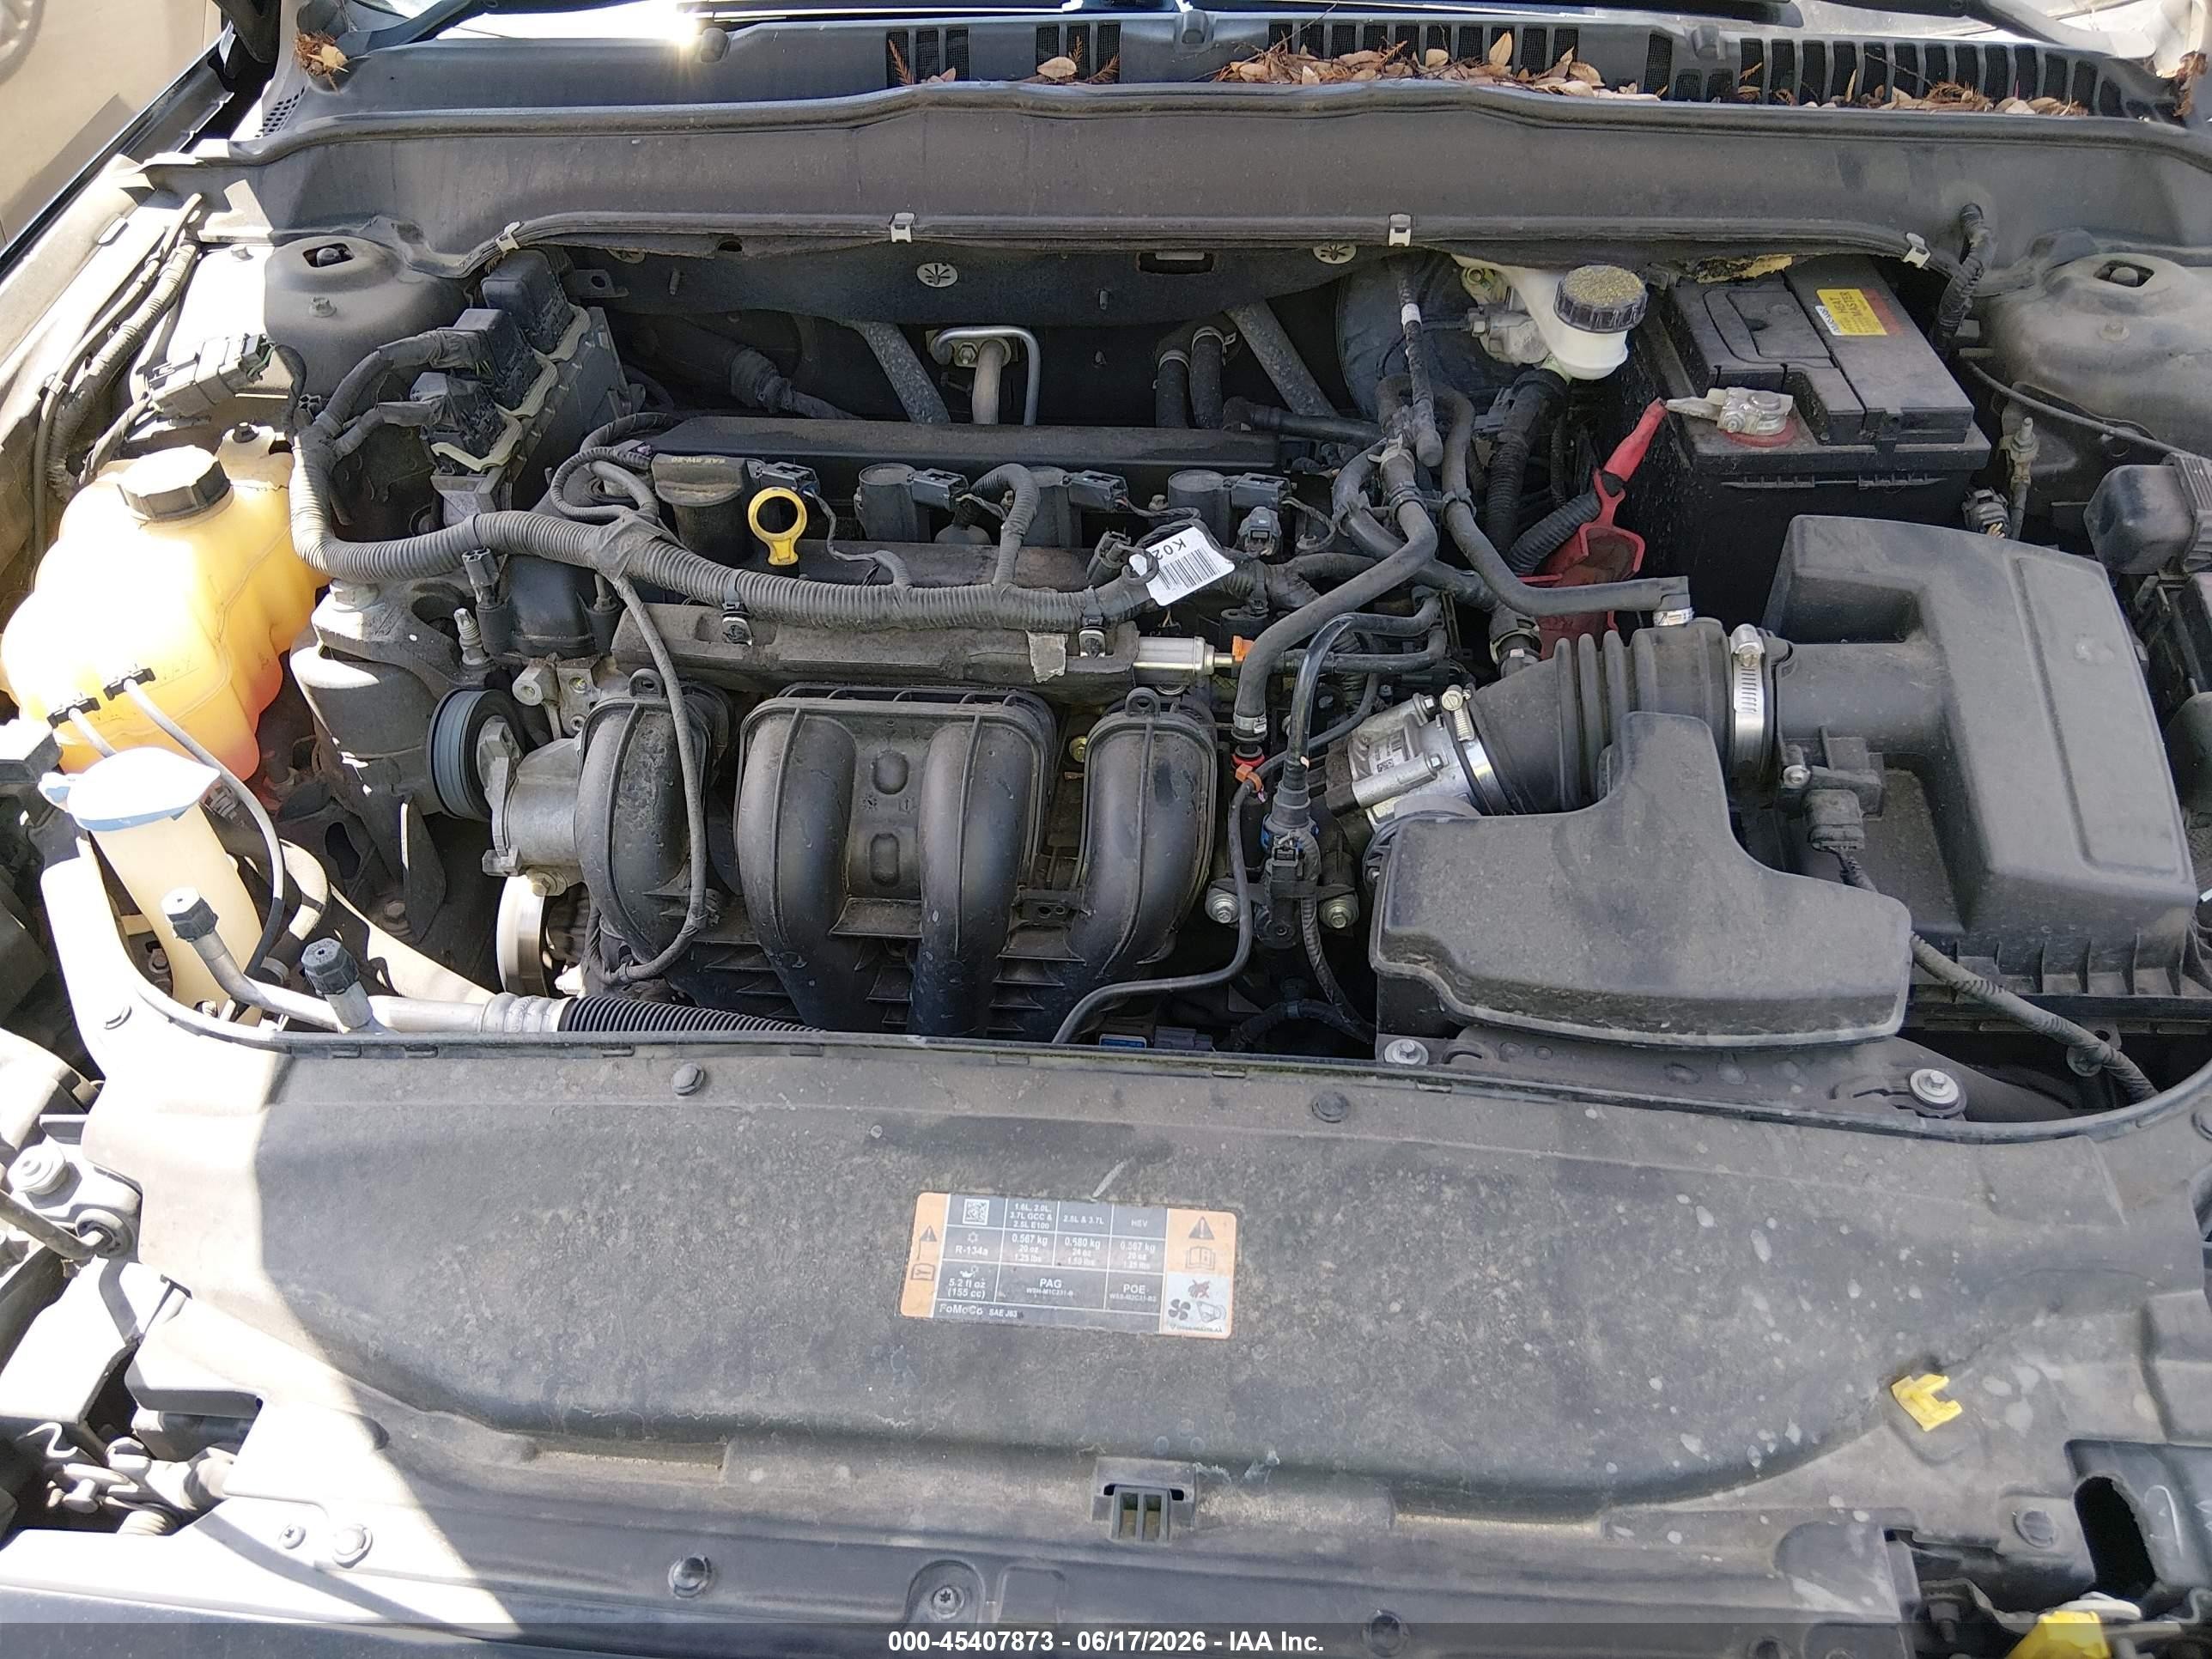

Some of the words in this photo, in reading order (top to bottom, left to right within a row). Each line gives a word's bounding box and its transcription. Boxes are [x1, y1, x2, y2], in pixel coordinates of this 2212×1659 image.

[1037, 1235, 1048, 1246] kg
[1090, 1238, 1101, 1250] kg
[955, 1245, 988, 1256] R-134a
[1145, 1242, 1156, 1254] kg
[1138, 1253, 1147, 1261] oz
[949, 1278, 963, 1287] 5.2
[965, 1279, 972, 1288] fl
[1039, 1278, 1062, 1288] PAG
[947, 1288, 968, 1297] (155
[970, 1290, 985, 1299] cc)
[1123, 1284, 1146, 1294] POE
[939, 1304, 983, 1316] FoMoCo
[989, 1309, 1004, 1317] SAE
